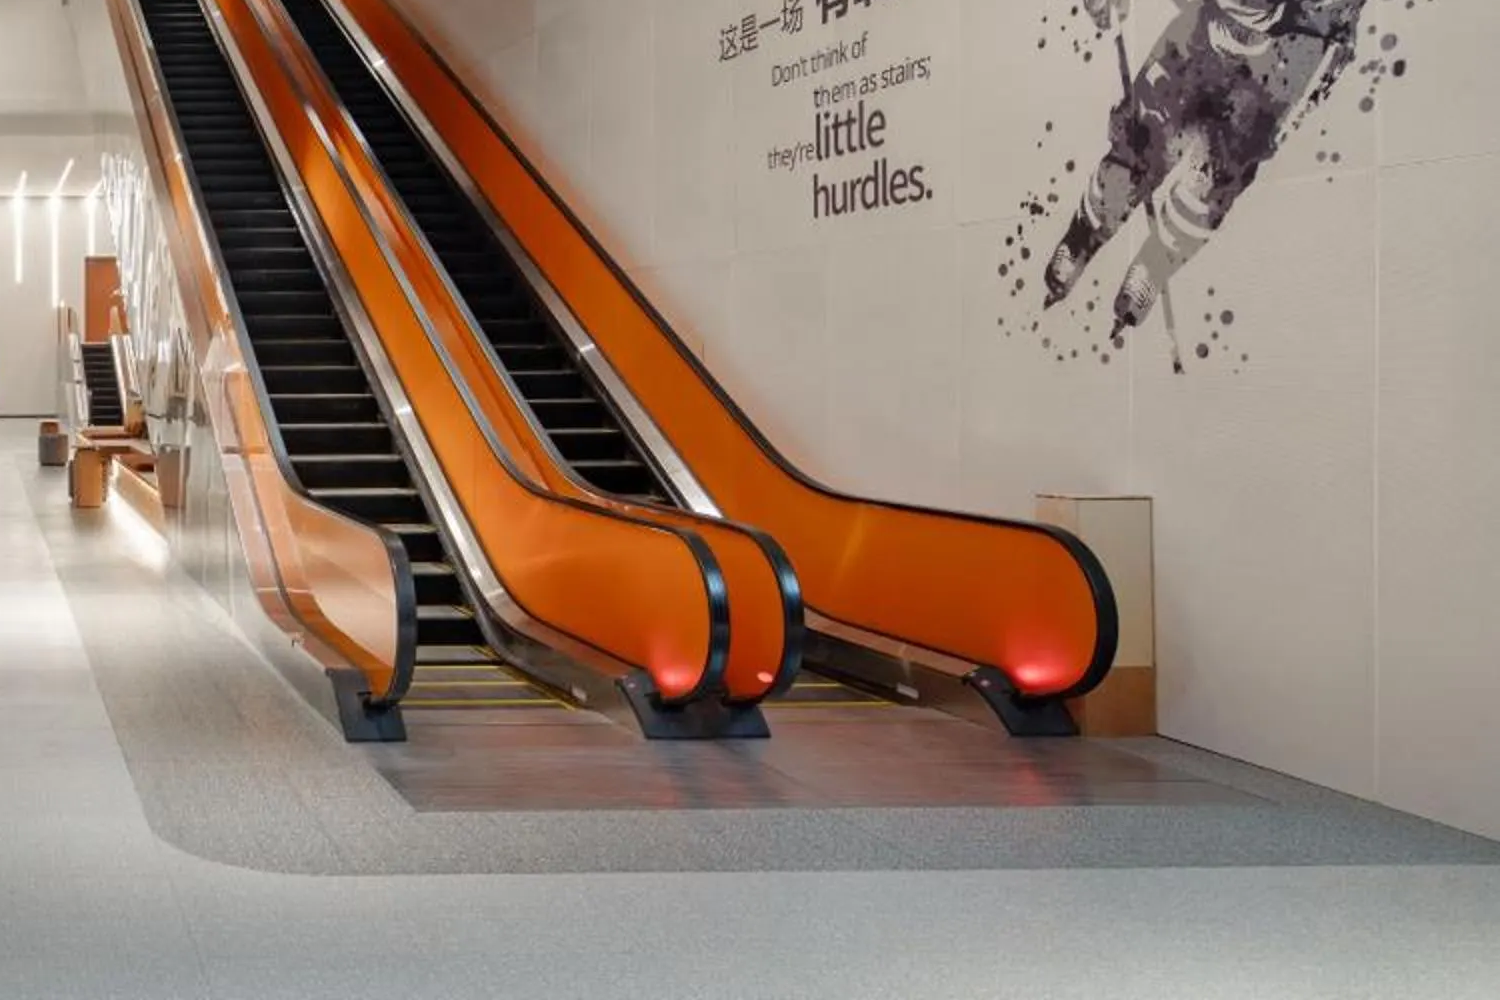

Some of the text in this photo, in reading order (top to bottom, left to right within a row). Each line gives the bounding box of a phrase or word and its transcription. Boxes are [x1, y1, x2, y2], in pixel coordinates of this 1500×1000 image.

[811, 40, 849, 74] think
[852, 31, 869, 59] of
[813, 83, 856, 108] them
[859, 72, 877, 96] as
[768, 100, 887, 172] they're little
[813, 157, 933, 219] hurdles.
